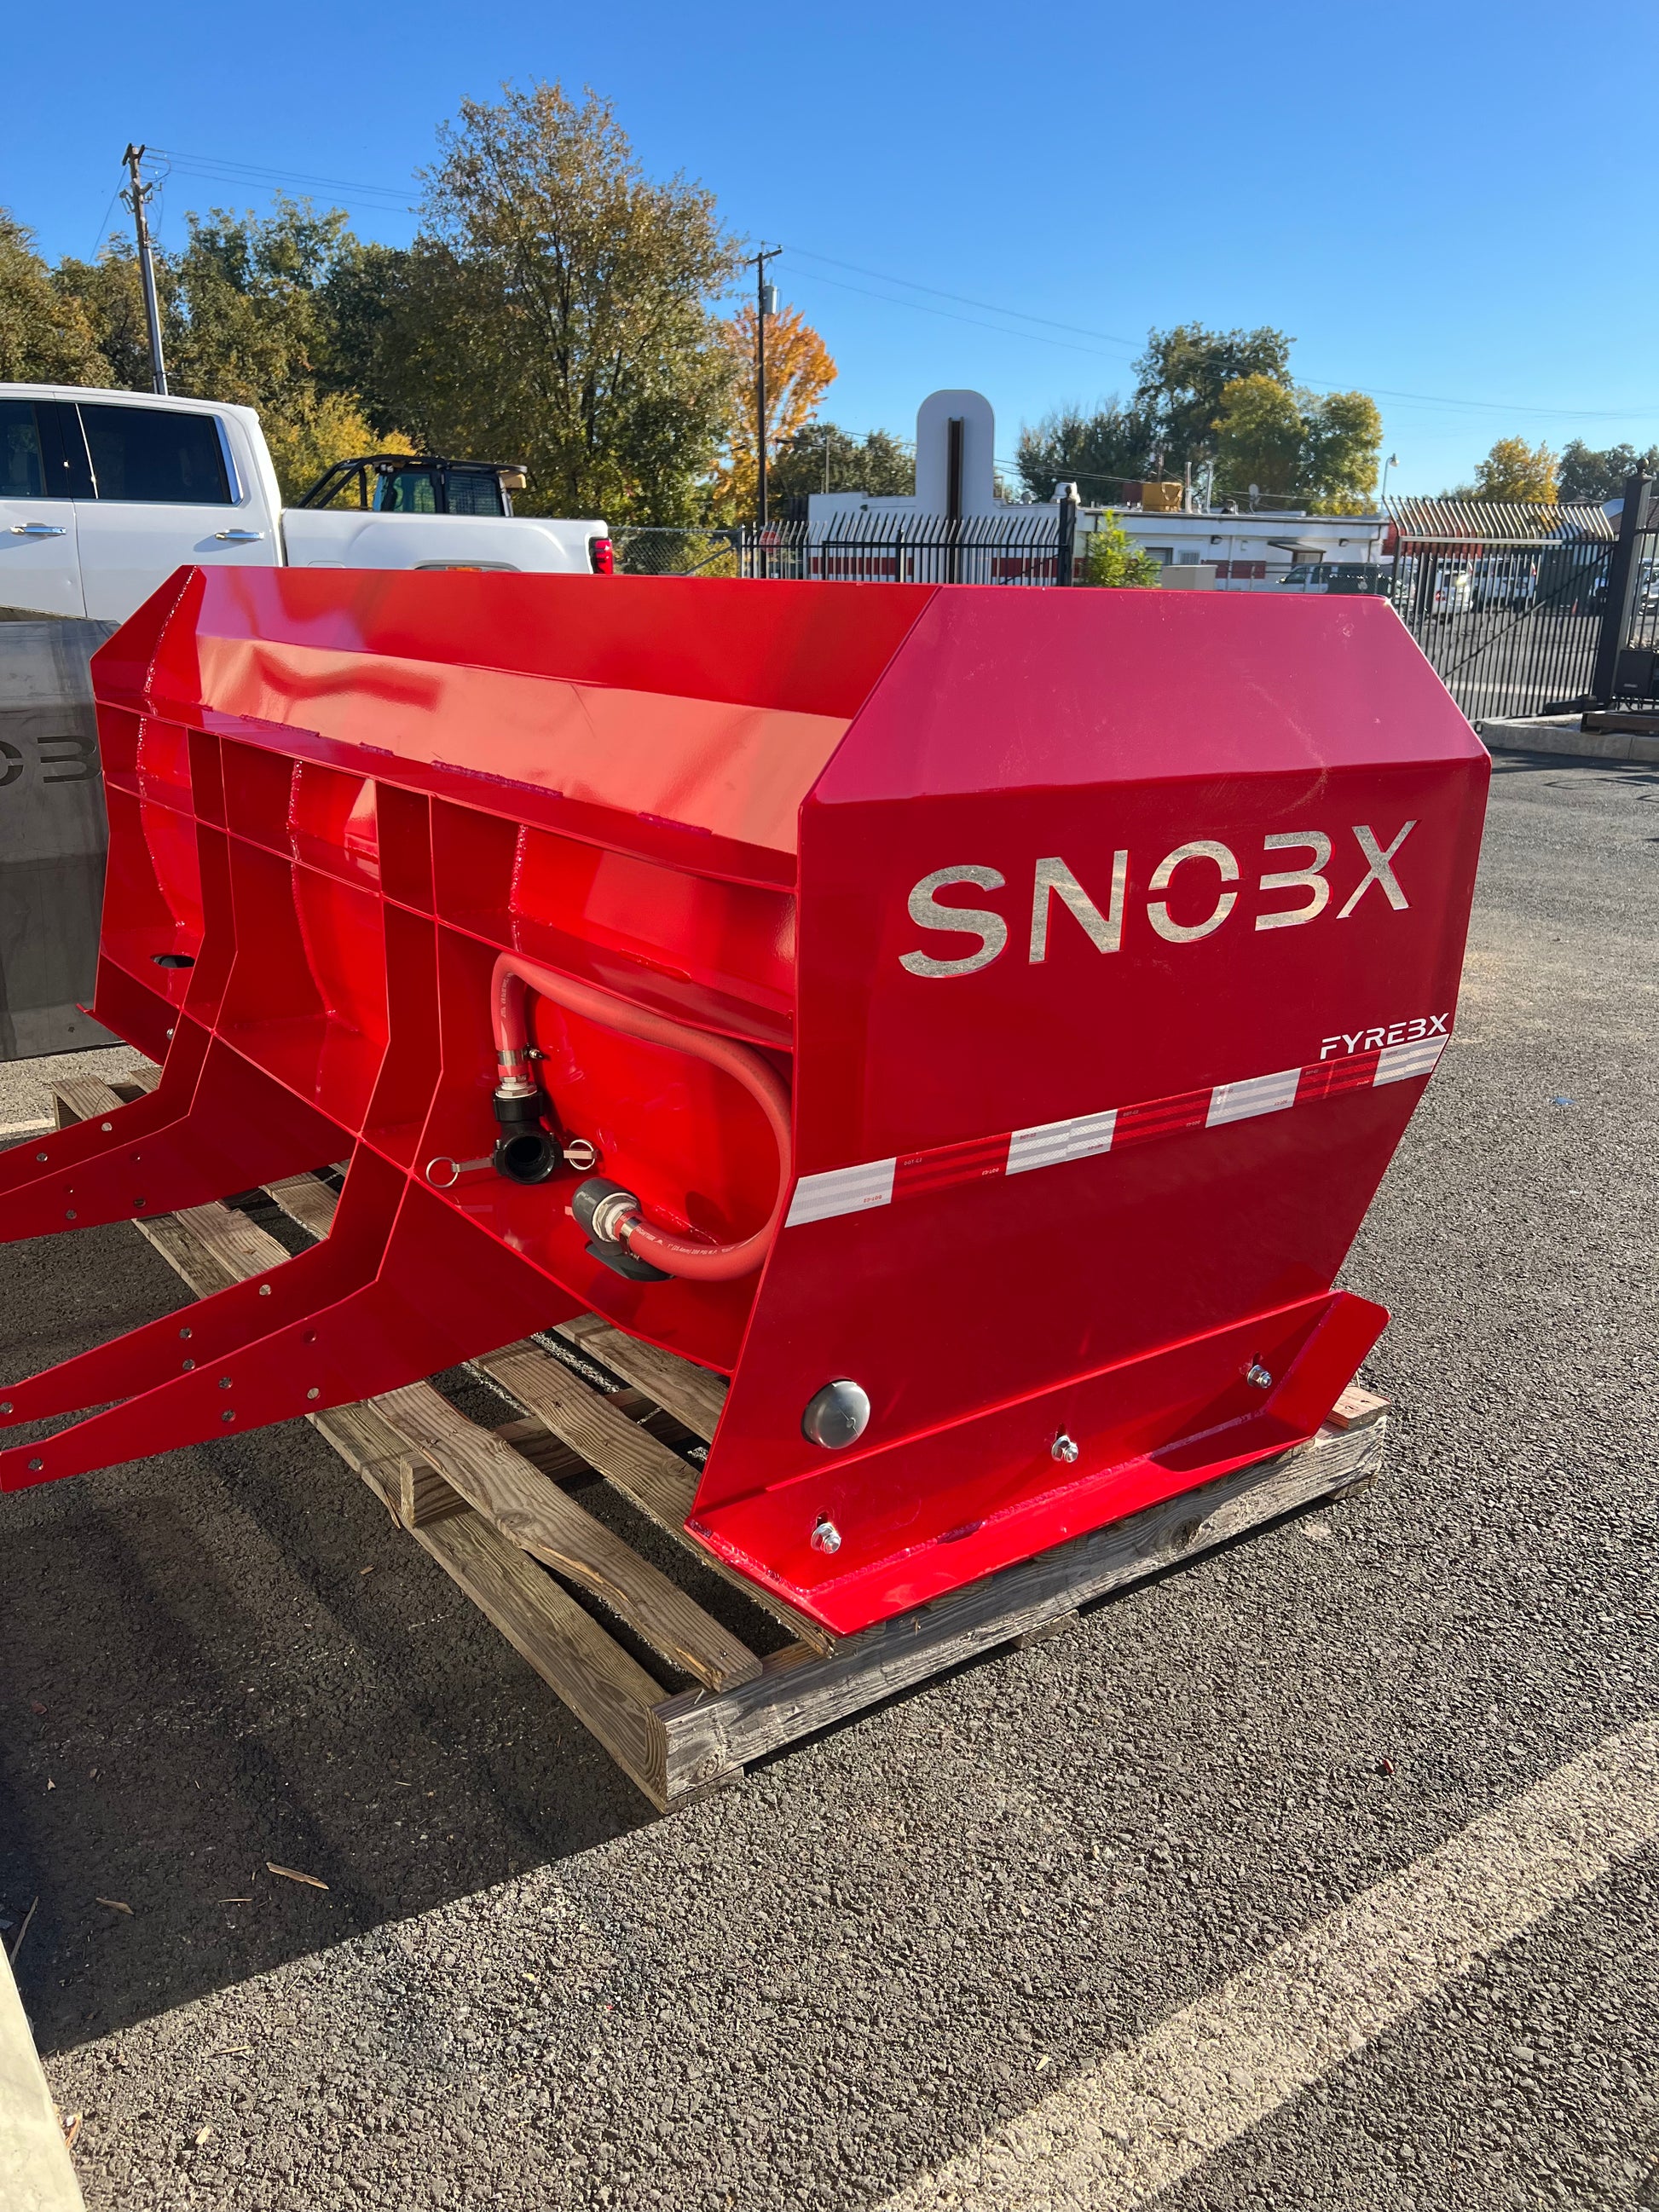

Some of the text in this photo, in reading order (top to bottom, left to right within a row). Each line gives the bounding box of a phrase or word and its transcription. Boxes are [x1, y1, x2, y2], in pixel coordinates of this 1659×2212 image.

[898, 819, 1421, 979] SNOBX
[1320, 1013, 1449, 1060] FYREBX
[904, 1157, 922, 1166] DOT-C2
[981, 1167, 999, 1175] DOT-C2
[864, 1194, 882, 1203] DOT-C2
